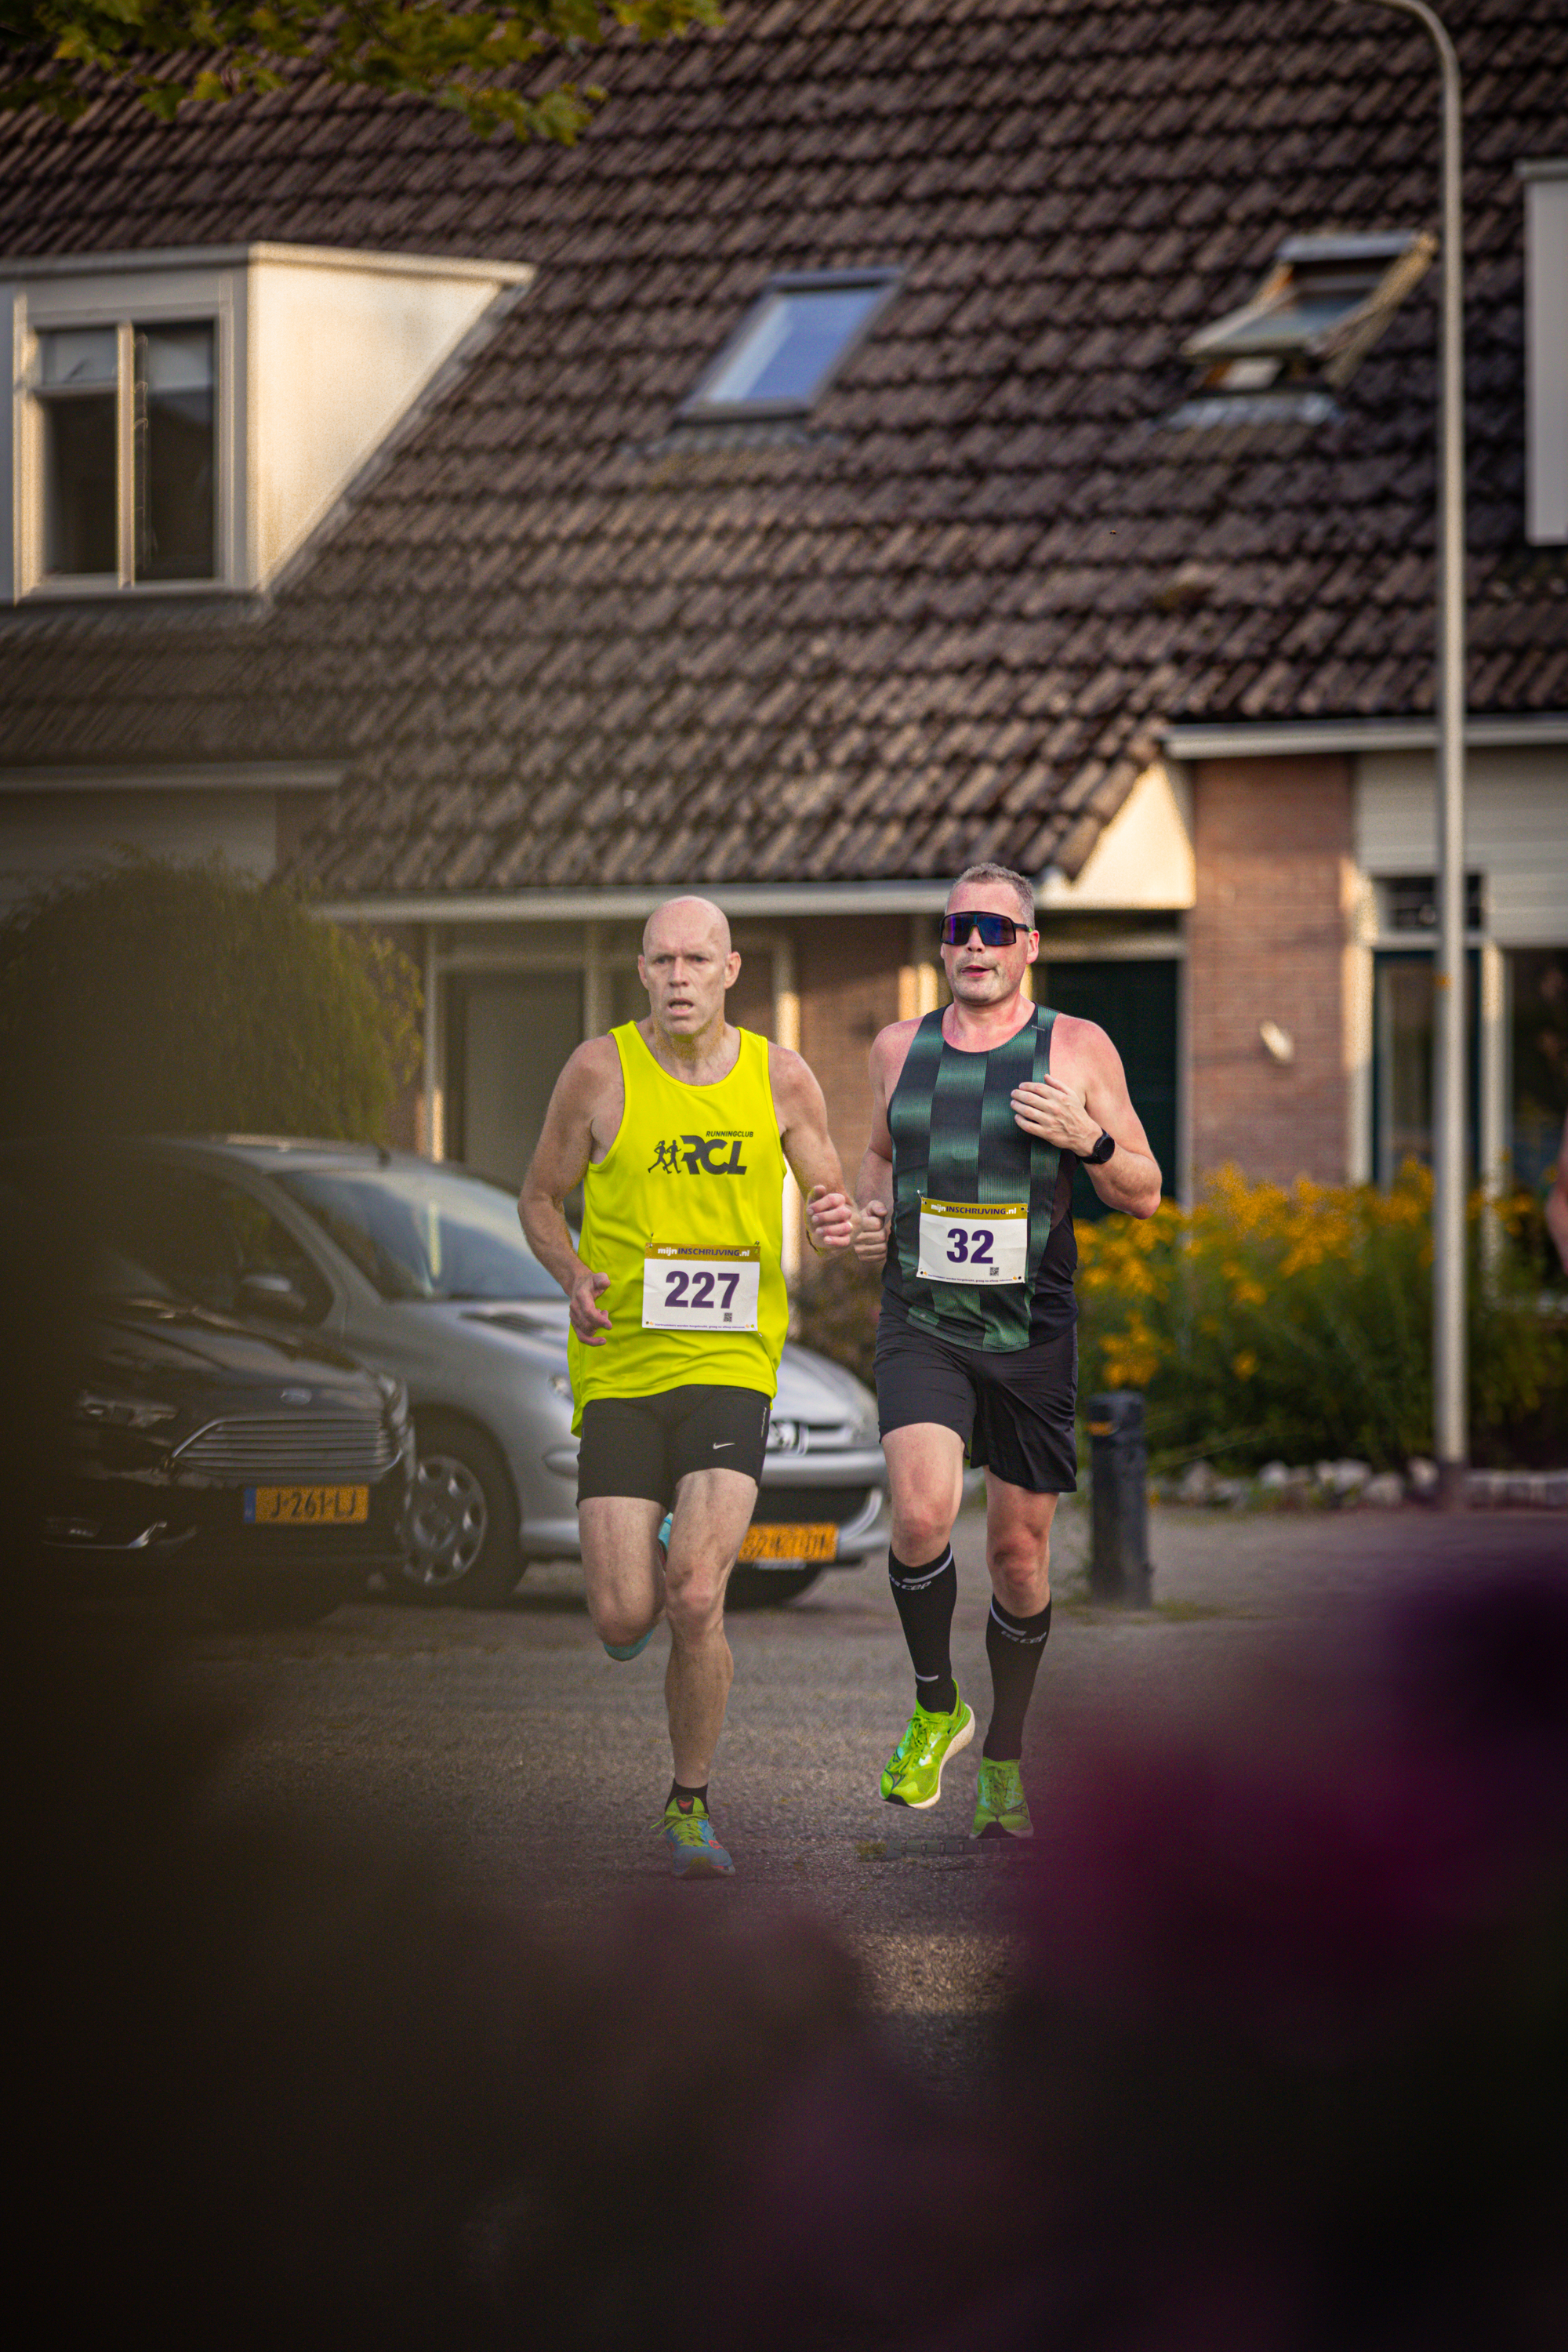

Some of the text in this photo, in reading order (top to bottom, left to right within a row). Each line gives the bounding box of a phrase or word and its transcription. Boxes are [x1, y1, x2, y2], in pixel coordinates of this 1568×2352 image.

[680, 1134, 747, 1175] RCL
[931, 1203, 1017, 1215] mijnINSCHRIJVING.nl
[658, 1247, 750, 1257] mijnINSCHRIJVING.nl
[946, 1228, 994, 1264] 32
[664, 1270, 740, 1309] 227
